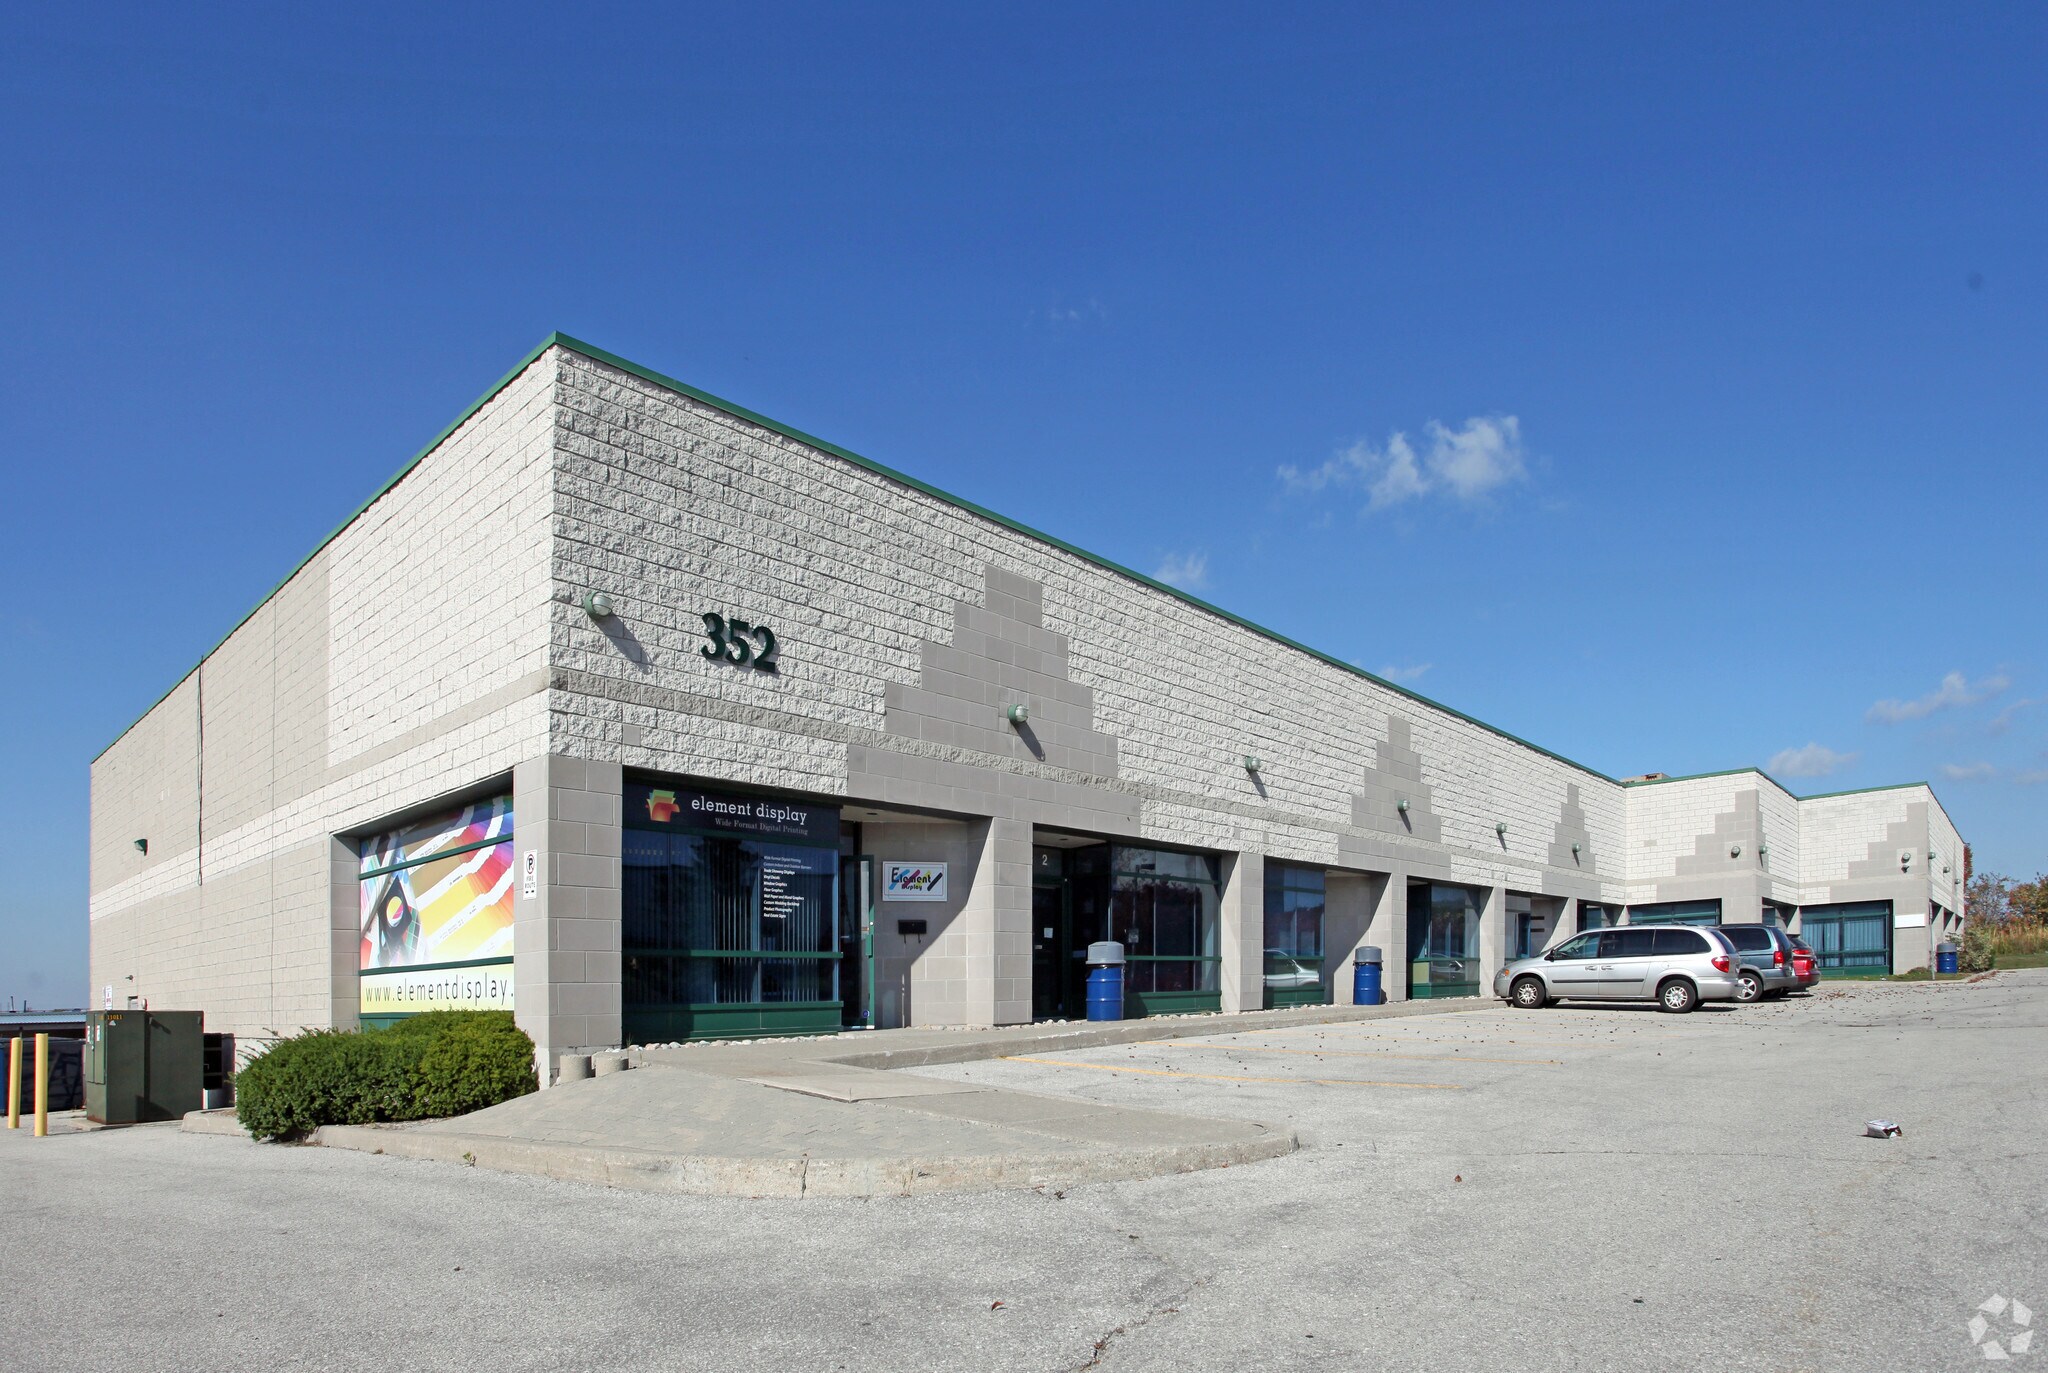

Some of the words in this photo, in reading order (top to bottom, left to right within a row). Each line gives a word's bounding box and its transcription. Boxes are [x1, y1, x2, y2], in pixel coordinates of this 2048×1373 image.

[700, 612, 776, 674] 352
[691, 795, 751, 816] element
[756, 803, 808, 825] display
[715, 817, 732, 827] Wide
[733, 820, 757, 830] Format
[759, 822, 781, 832] Digital
[782, 825, 809, 836] Printing
[1042, 854, 1048, 866] 2
[891, 866, 931, 883] Element
[365, 972, 514, 1007] www.elementdisplay.
